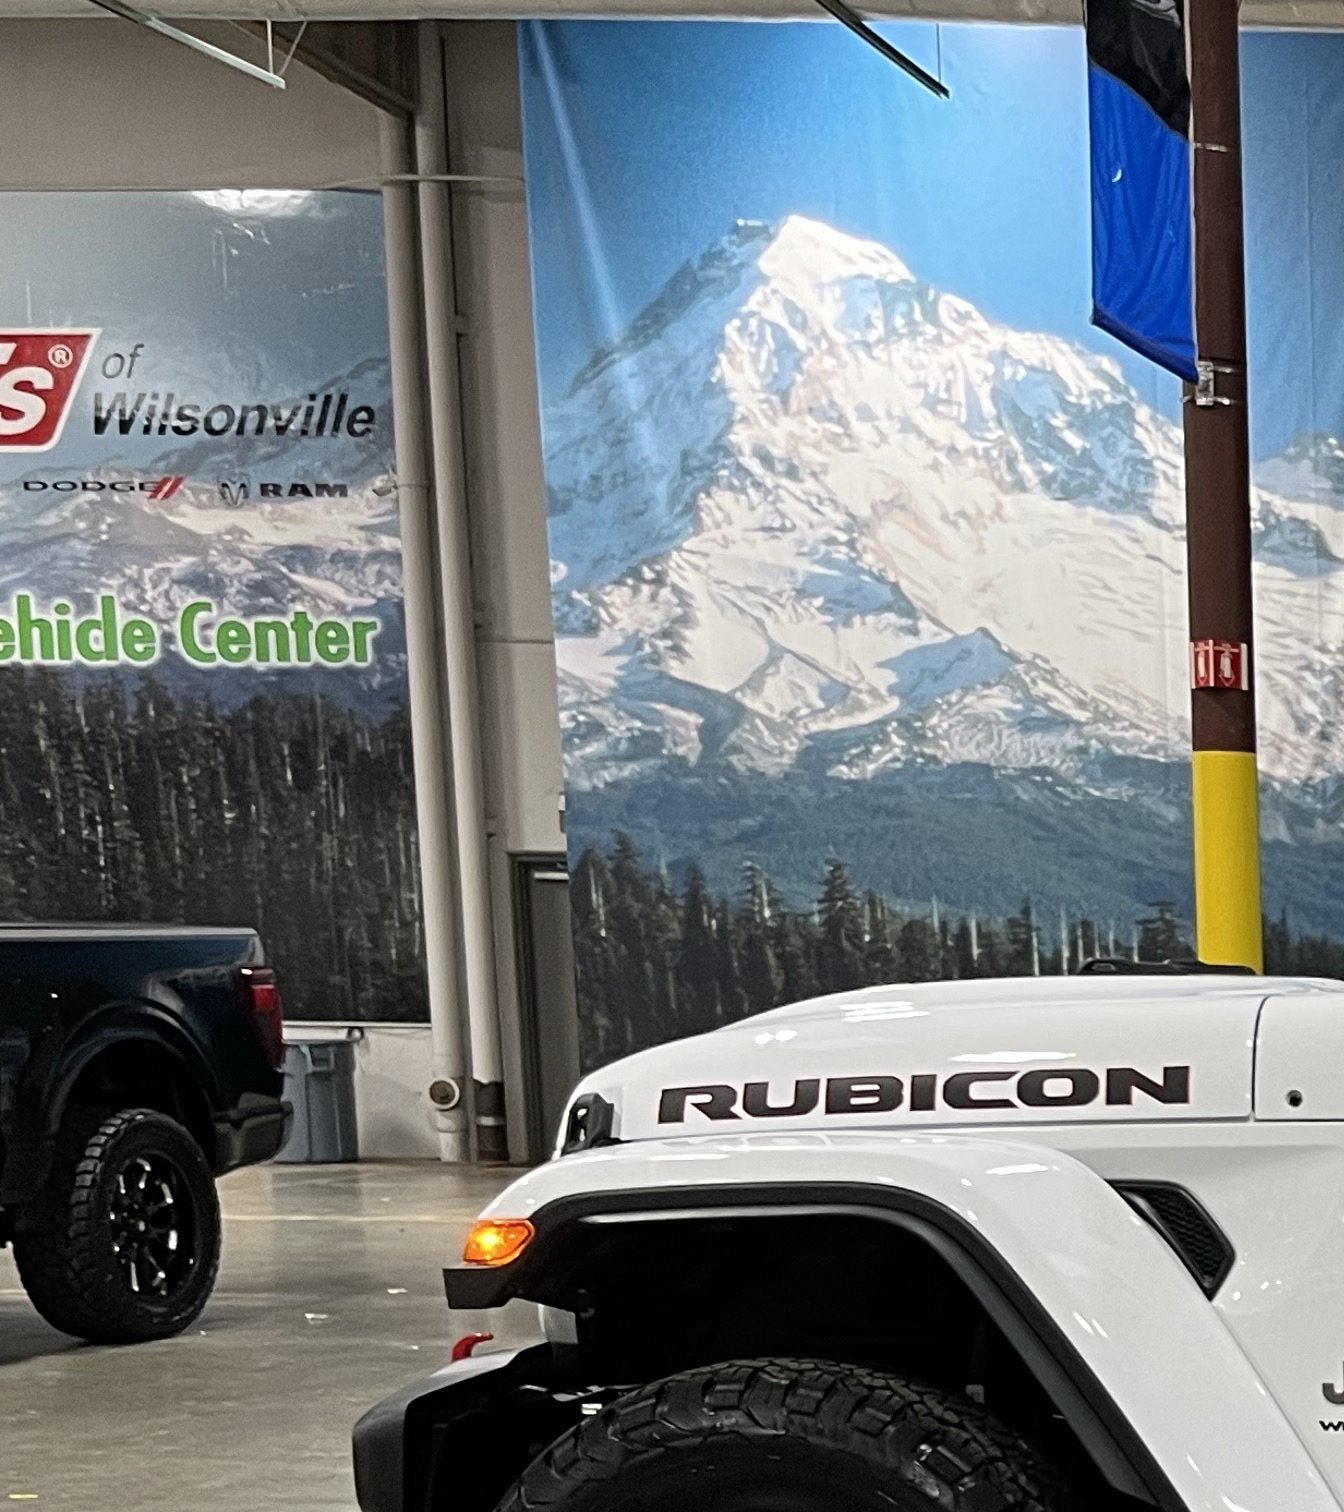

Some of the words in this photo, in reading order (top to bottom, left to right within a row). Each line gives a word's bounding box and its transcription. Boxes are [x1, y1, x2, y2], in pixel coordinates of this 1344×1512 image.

[102, 343, 145, 379] of
[93, 392, 376, 438] Wilsonville
[23, 481, 160, 493] DODGE
[259, 483, 349, 498] RAM
[180, 601, 378, 664] Center
[657, 1065, 1191, 1124] RUBICON
